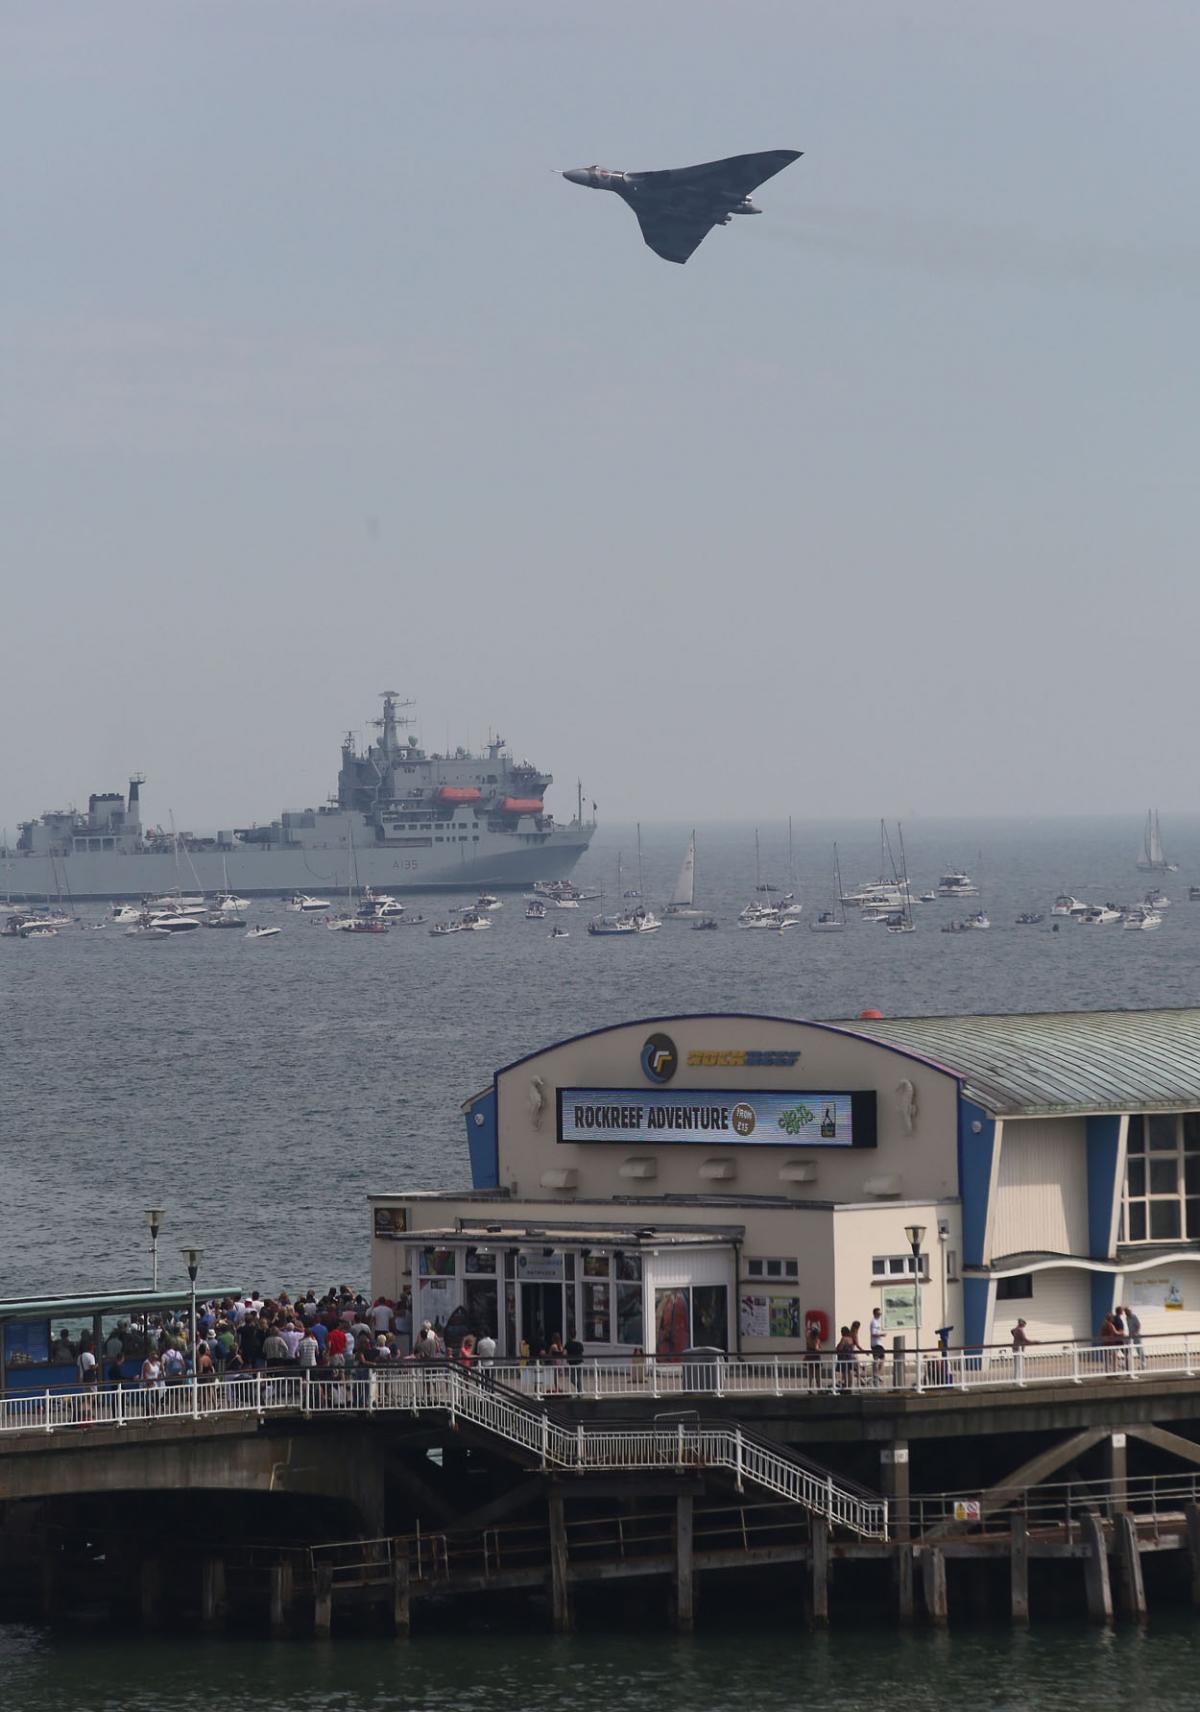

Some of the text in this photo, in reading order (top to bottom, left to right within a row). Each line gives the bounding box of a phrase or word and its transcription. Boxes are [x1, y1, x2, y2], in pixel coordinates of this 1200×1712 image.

[392, 859, 418, 870] A135
[575, 1105, 728, 1130] ROCKREEF ADVENTURE
[736, 1108, 753, 1120] FROM
